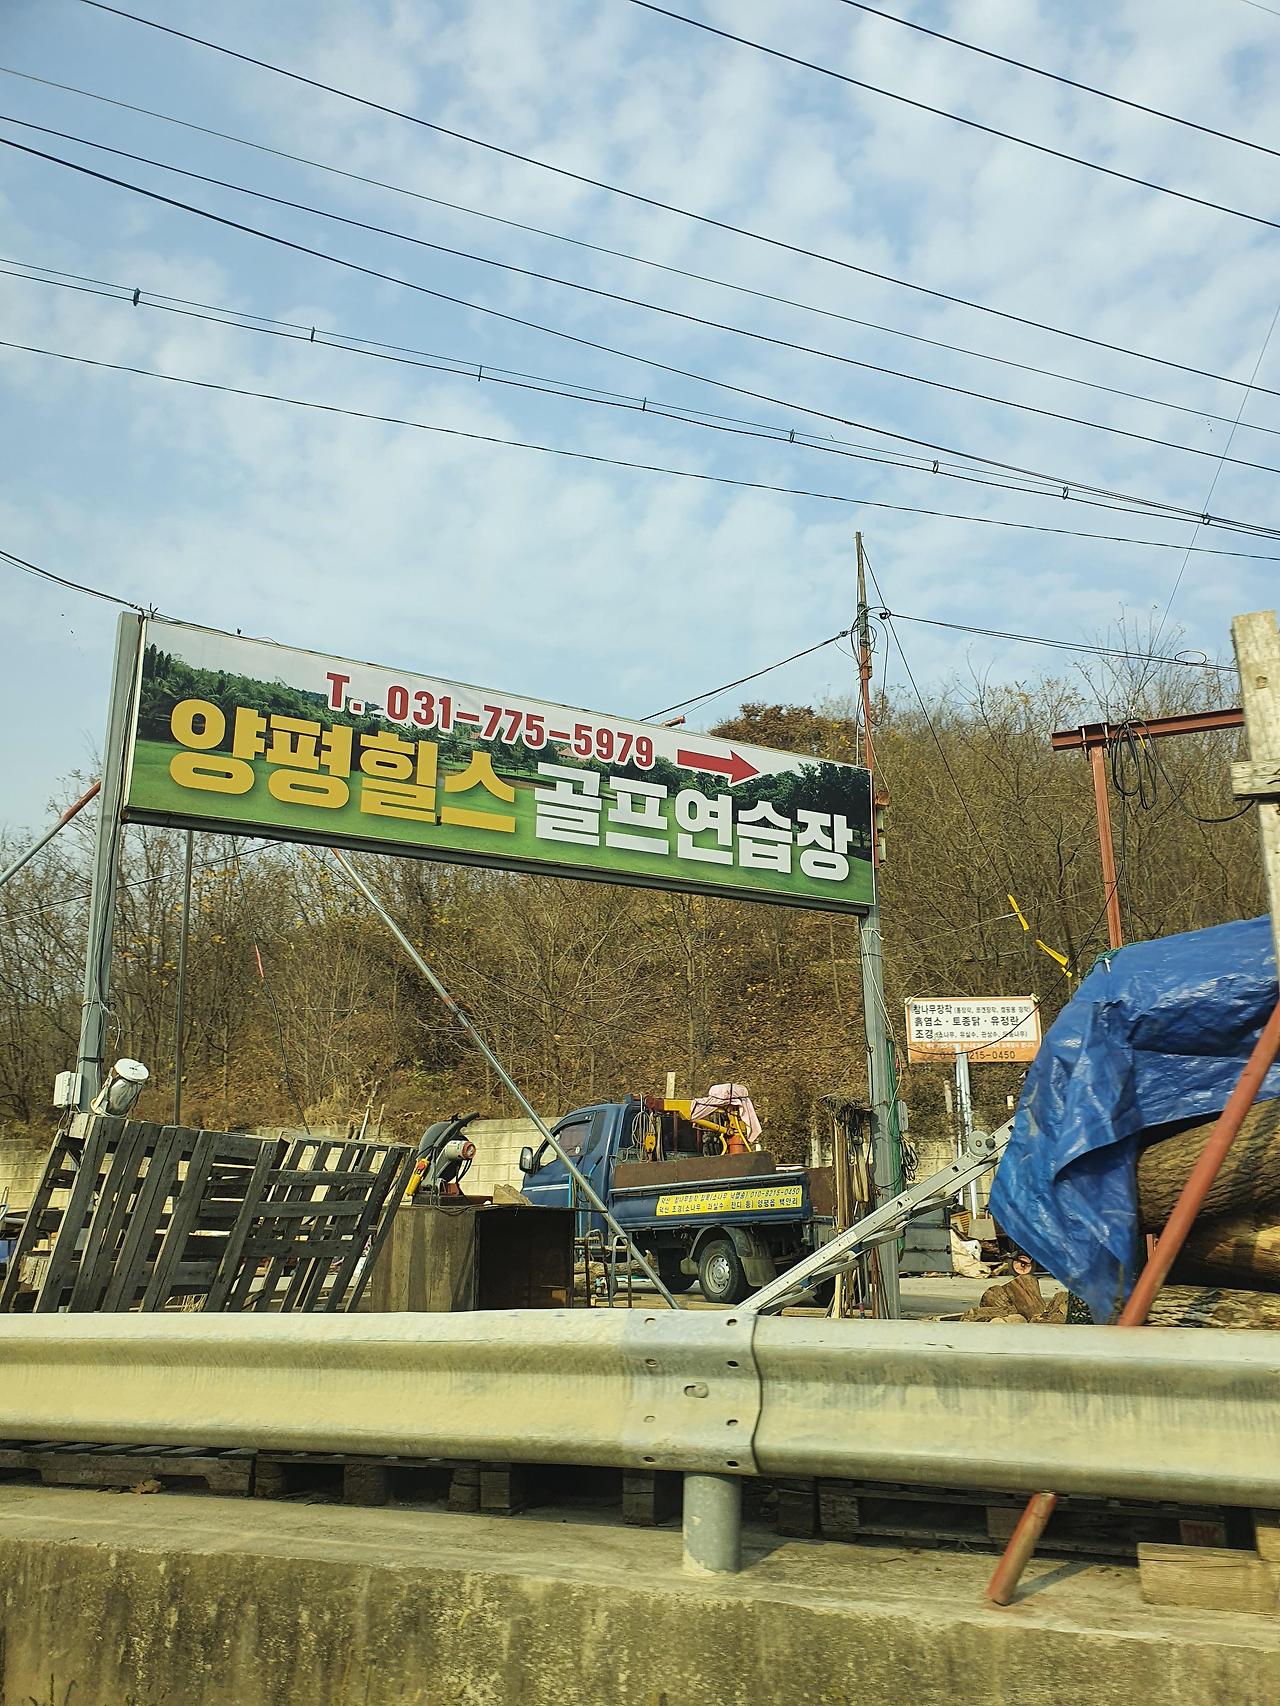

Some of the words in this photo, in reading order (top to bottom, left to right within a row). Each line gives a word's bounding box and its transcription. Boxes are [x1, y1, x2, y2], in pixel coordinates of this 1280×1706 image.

[327, 671, 363, 714] T.
[386, 685, 654, 767] 031-775-5979
[169, 699, 516, 833] 양평힐스
[534, 761, 854, 881] 골프연습장
[913, 1004, 952, 1014] 참나무장작
[952, 1016, 980, 1026] 토종닭
[990, 1016, 1019, 1026] 유정란
[915, 1029, 933, 1039] 조경
